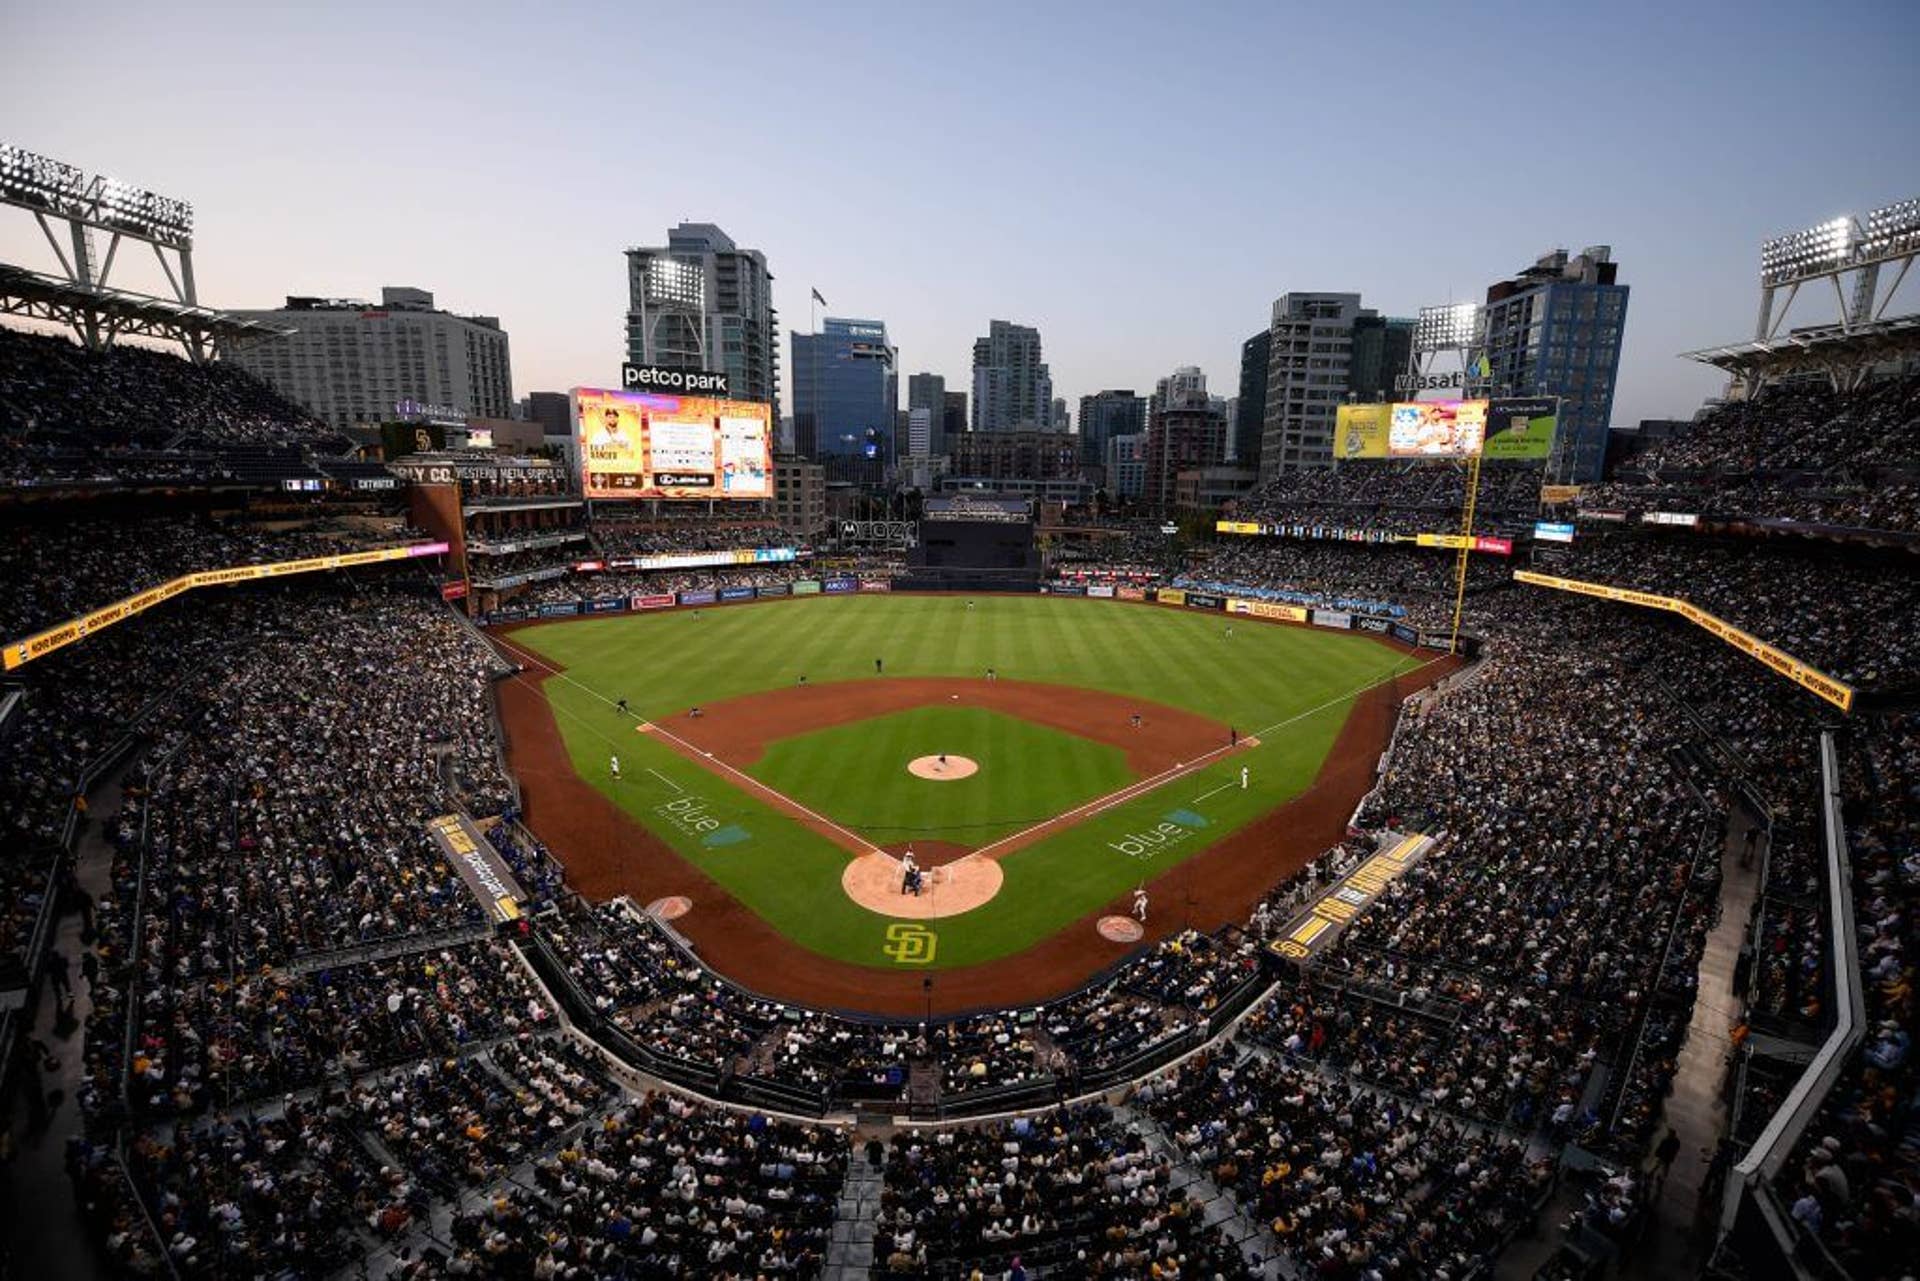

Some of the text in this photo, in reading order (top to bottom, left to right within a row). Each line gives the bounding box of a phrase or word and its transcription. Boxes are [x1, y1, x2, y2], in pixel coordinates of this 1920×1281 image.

[625, 366, 727, 391] petco park
[1395, 372, 1464, 391] Viasat
[456, 467, 497, 480] WESTERN
[500, 467, 526, 480] METAL
[666, 796, 719, 832] blue
[1107, 822, 1182, 856] blue
[883, 923, 938, 964] SD
